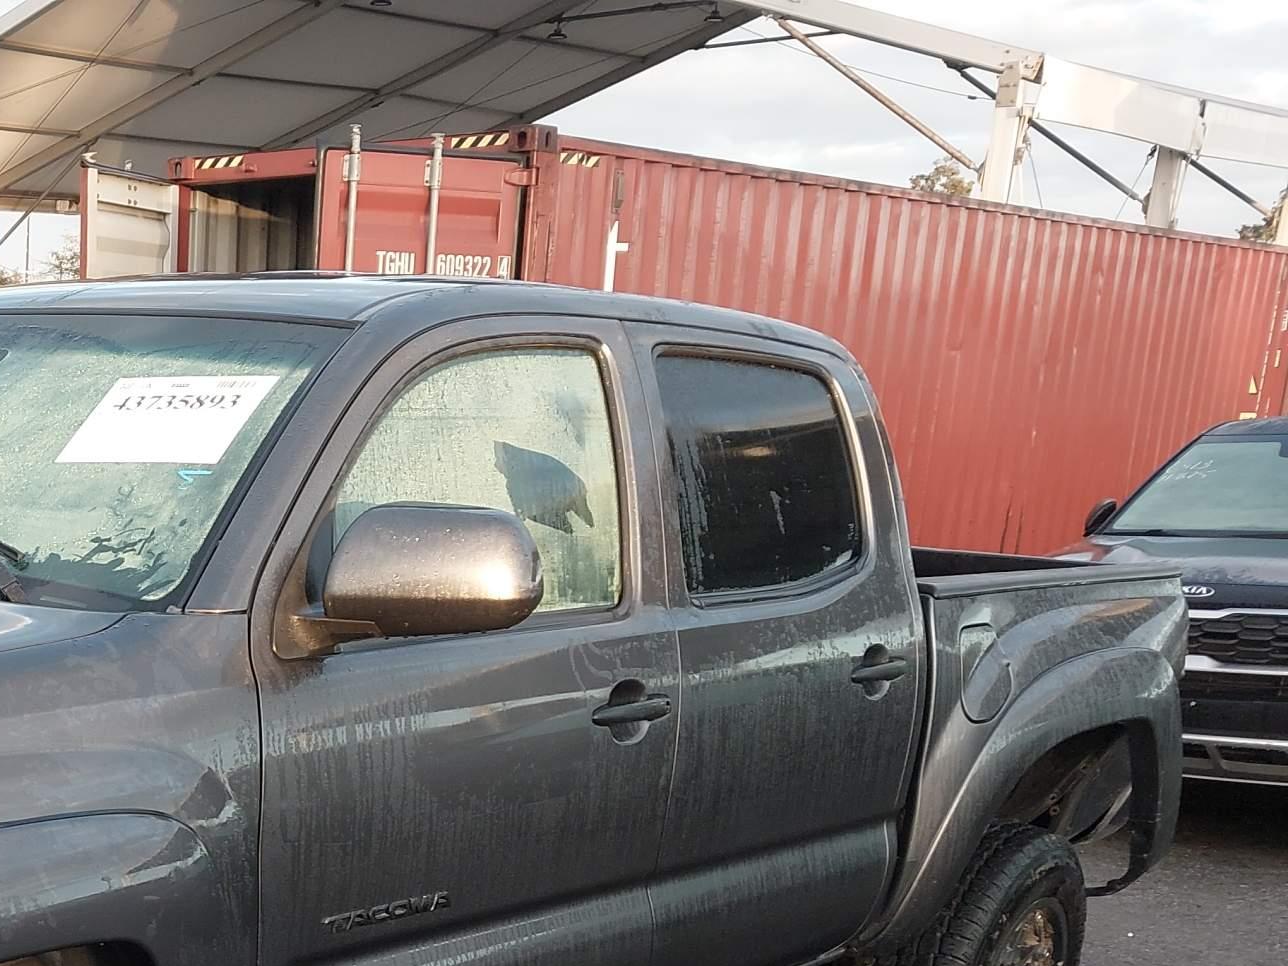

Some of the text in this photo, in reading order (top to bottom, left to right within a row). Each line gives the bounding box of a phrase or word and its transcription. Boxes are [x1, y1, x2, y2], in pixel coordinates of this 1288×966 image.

[376, 251, 416, 275] TGHU
[436, 254, 491, 278] 609322
[113, 394, 241, 411] 43735893
[320, 891, 450, 933] TACOMA
